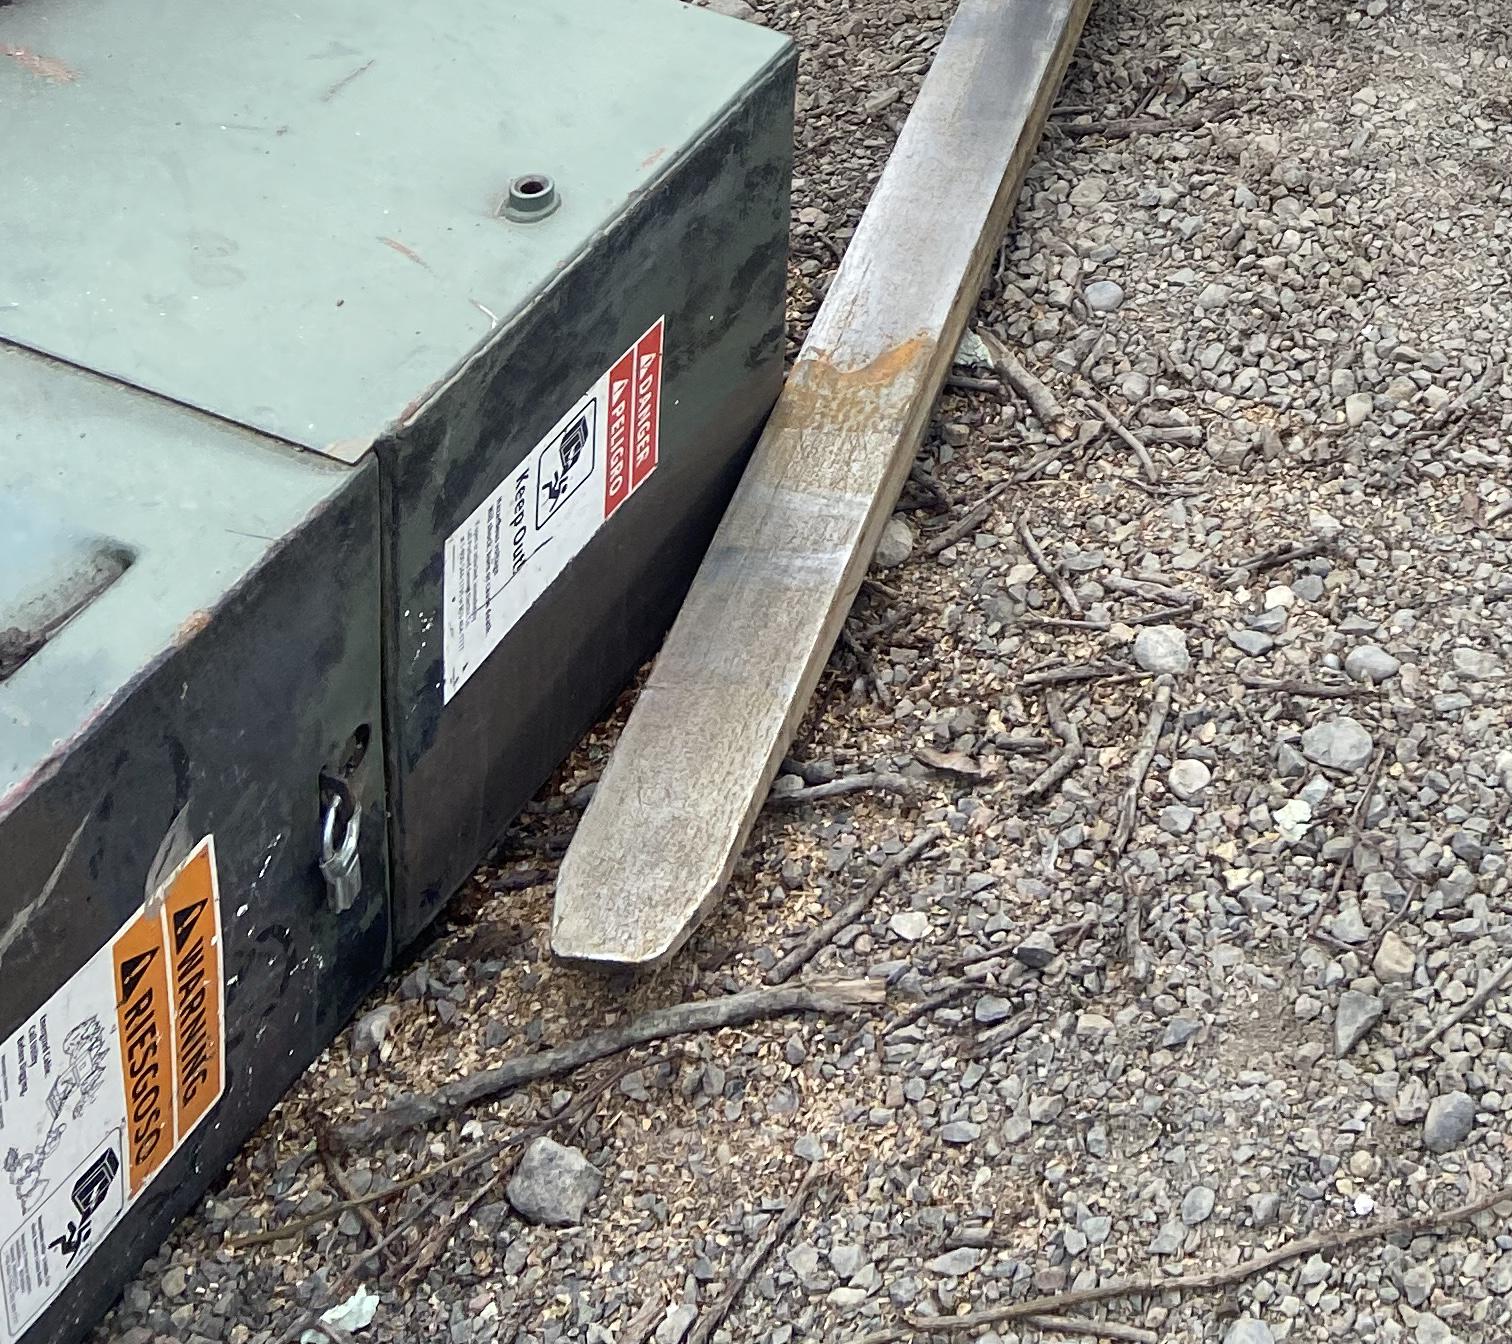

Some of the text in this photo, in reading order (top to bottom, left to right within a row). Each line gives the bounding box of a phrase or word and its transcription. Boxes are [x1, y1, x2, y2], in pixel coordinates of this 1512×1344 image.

[609, 399, 626, 497] PELIGRO
[636, 374, 653, 469] DANGER
[510, 467, 530, 527] Keep
[177, 935, 208, 1108] WARNING
[124, 987, 161, 1165] RIESGOSO
